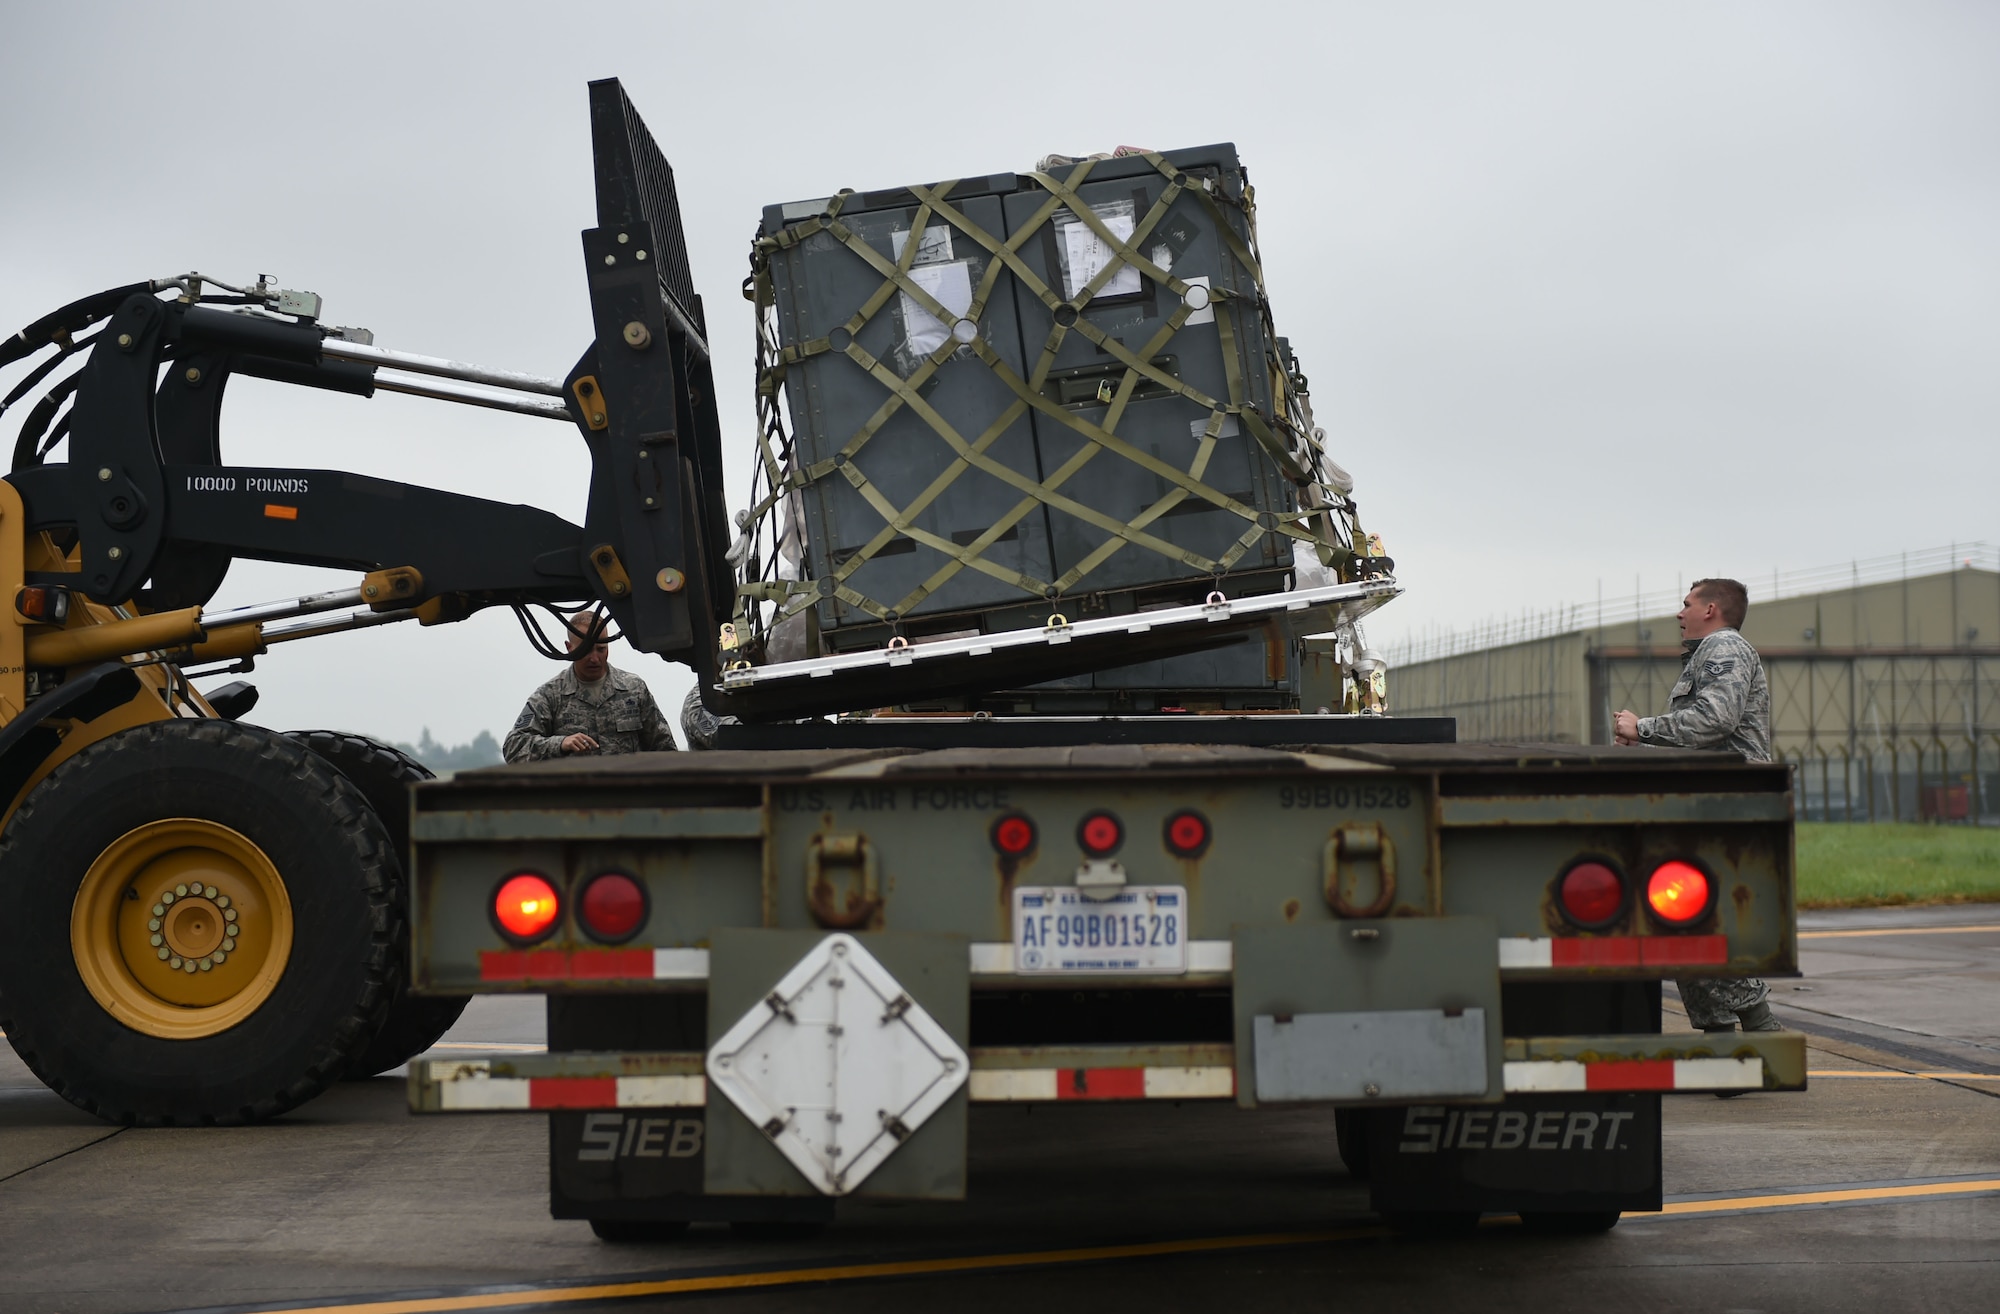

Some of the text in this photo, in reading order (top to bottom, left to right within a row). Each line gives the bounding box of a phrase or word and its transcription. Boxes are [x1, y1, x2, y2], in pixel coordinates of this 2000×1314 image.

[187, 476, 309, 493] 10000 POUNDS
[780, 784, 1010, 812] U.S. AIR FORCE
[1280, 784, 1412, 809] 99B01528
[1022, 914, 1177, 947] AF99B01528
[1399, 1106, 1634, 1152] SIEBERT
